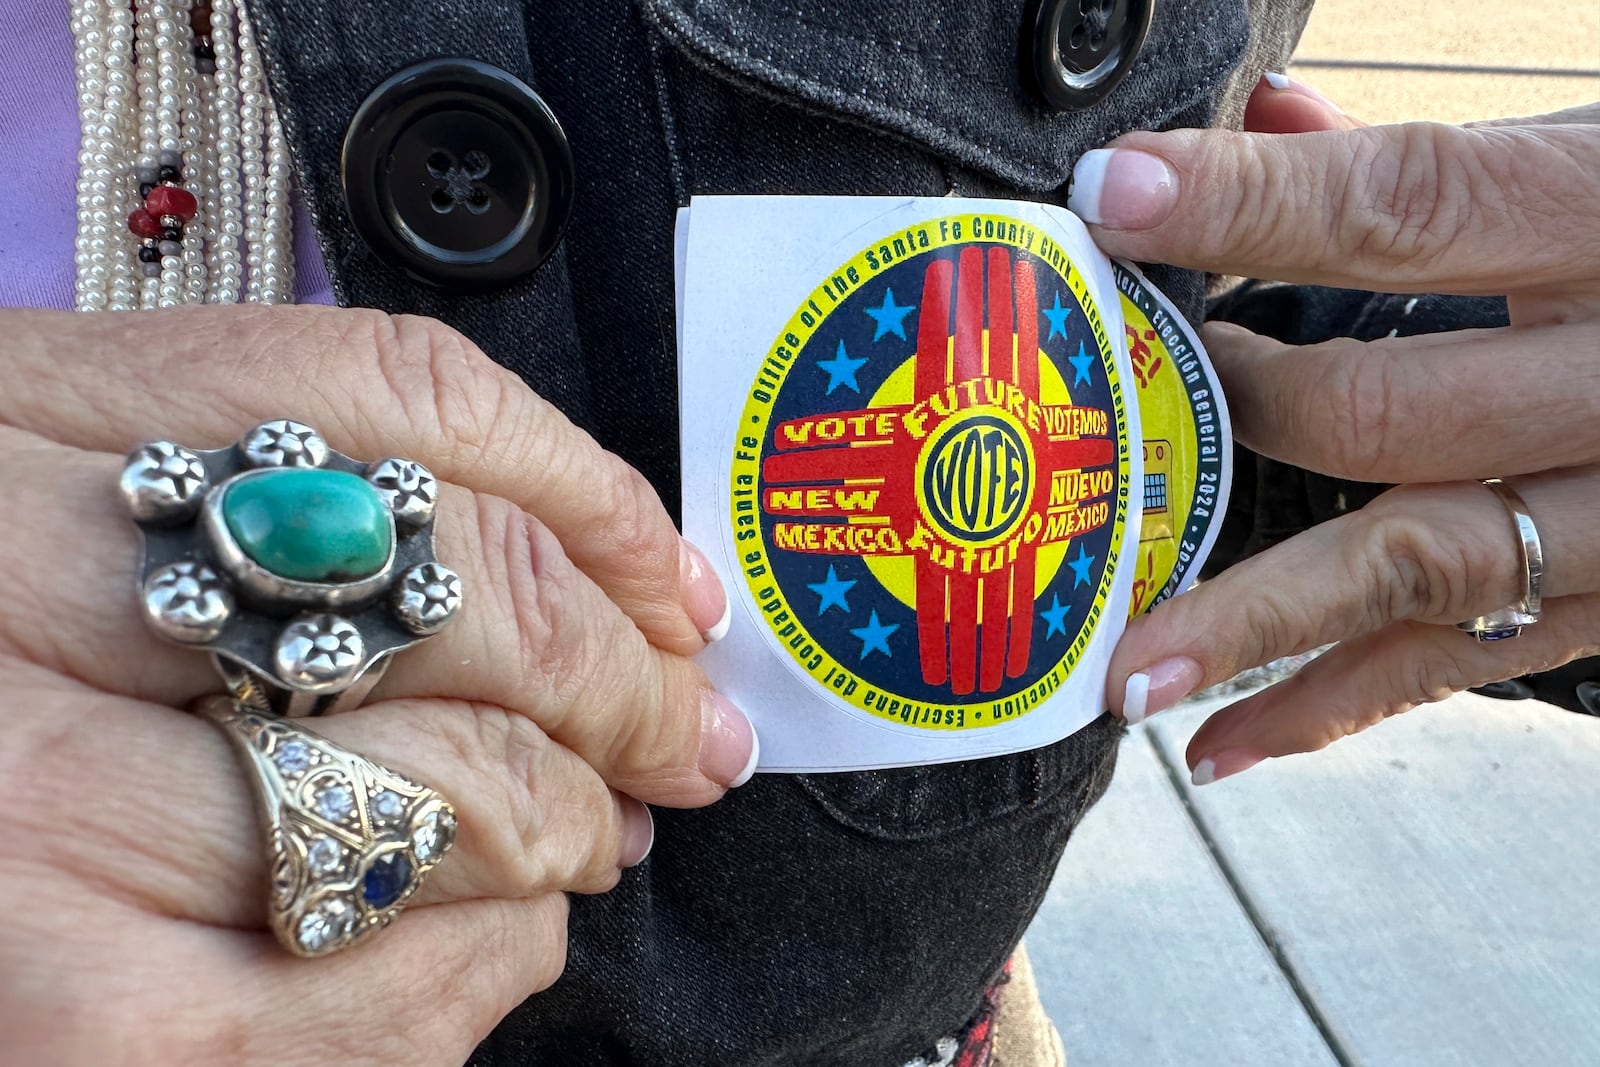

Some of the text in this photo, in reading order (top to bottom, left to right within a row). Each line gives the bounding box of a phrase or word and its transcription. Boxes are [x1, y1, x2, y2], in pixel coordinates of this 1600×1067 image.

[753, 217, 1072, 403] Office of the Santa Fe County Clerk
[783, 413, 899, 444] VOTE
[902, 377, 1041, 440] FUTURE
[1043, 407, 1108, 436] VOTEMOS
[1081, 289, 1129, 523] Elección General 2024
[1152, 310, 1219, 518] Elección General 2024
[770, 489, 880, 512] NEW
[936, 428, 1022, 531] VOTE
[1050, 470, 1114, 506] NUEVO
[774, 523, 903, 553] MEXICO
[734, 436, 965, 727] Escribana del Condado de Santa Fe
[992, 551, 1119, 719] 2024 General Election
